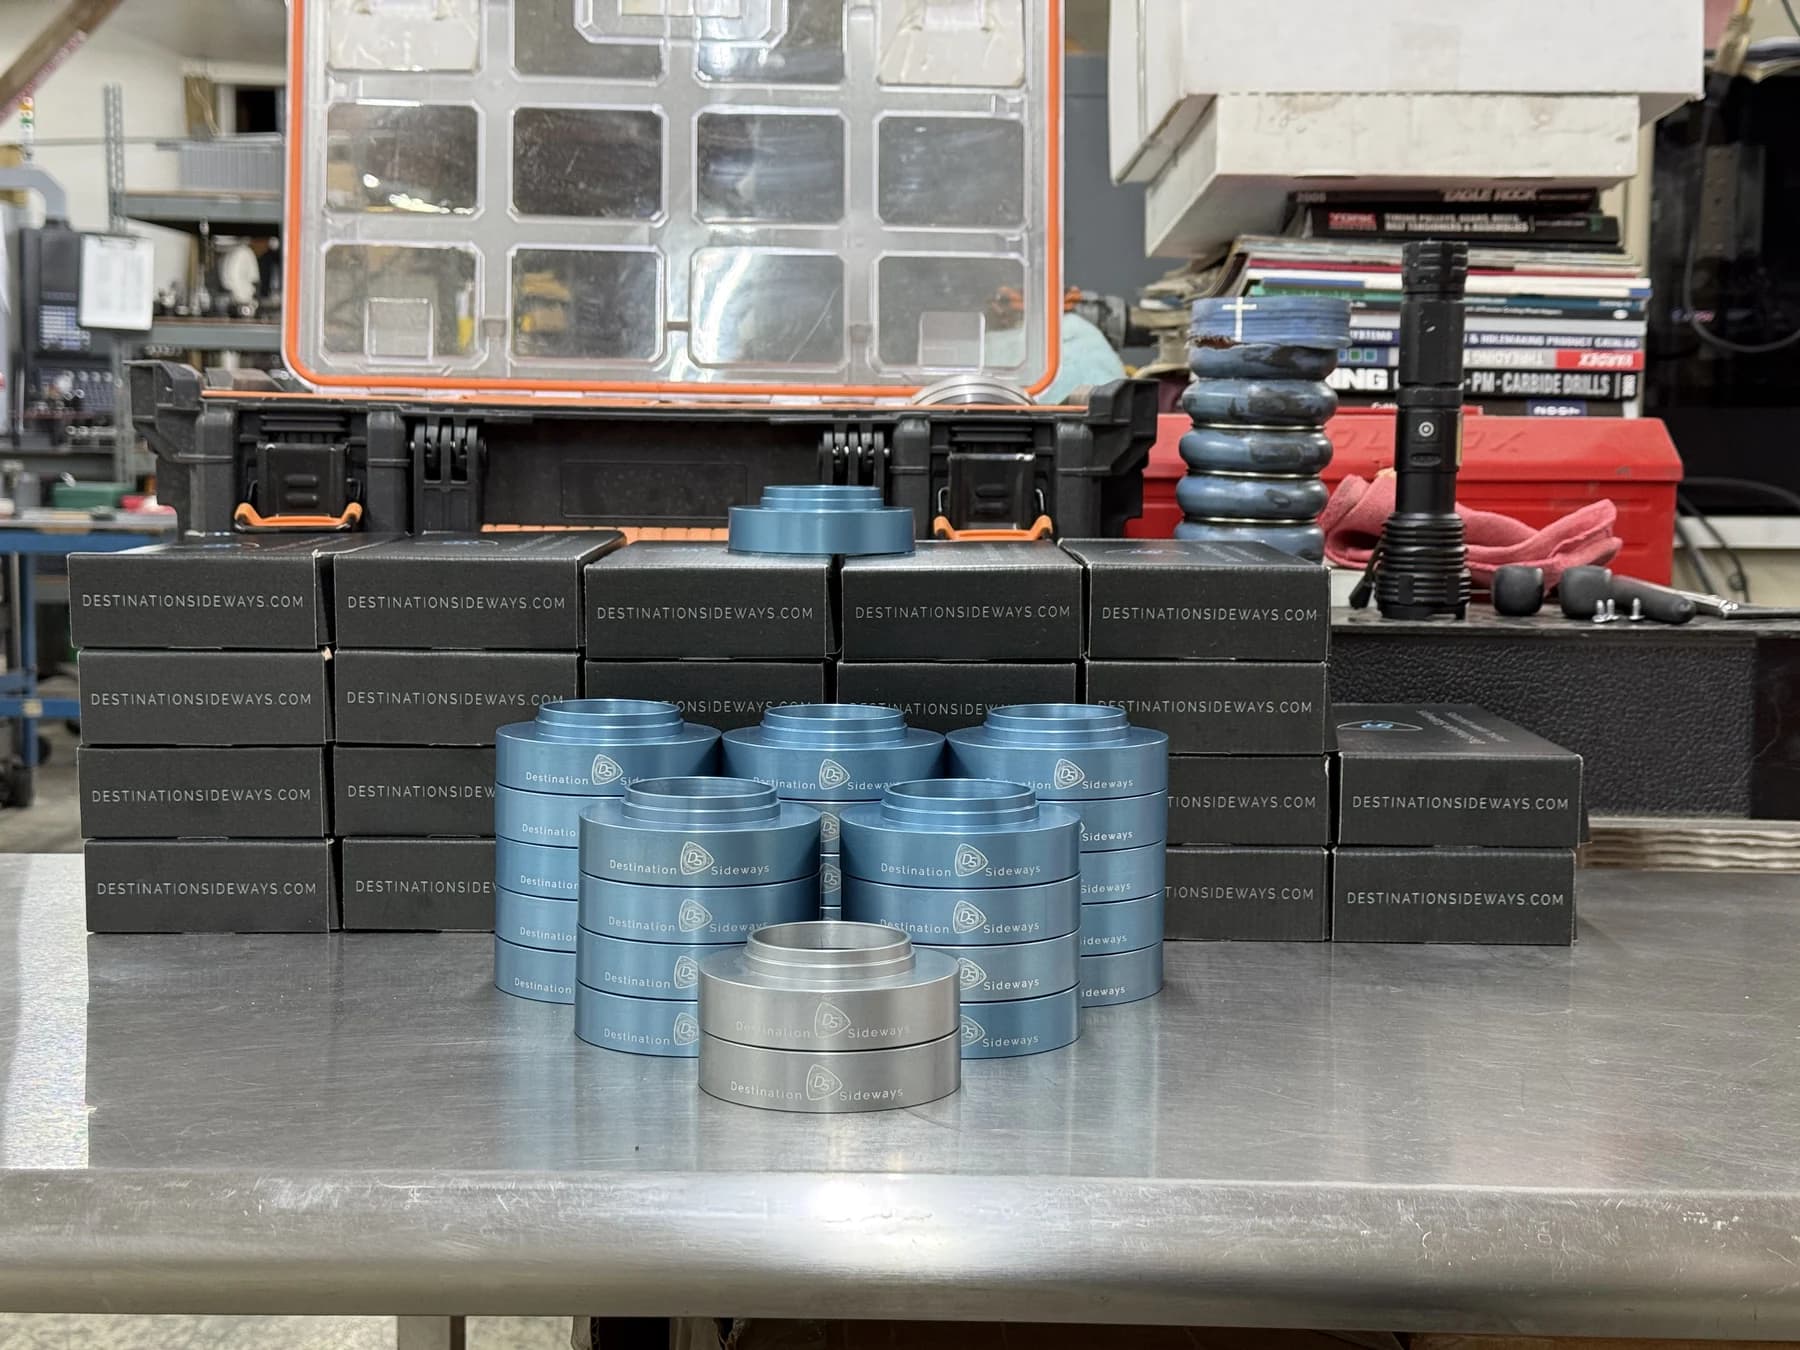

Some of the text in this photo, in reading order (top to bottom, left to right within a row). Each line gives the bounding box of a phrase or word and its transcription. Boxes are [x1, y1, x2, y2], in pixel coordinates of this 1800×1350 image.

[1562, 373, 1610, 396] DRILLS
[81, 594, 304, 608] DESTINATIONSIDEWAYS.COM
[347, 595, 566, 609] DESTINATIONSIDEWAYS.COM
[597, 606, 814, 620] DESTINATIONSIDEWAYS.COM
[855, 605, 1071, 619] DESTINATIONSIDEWAYS.COM
[1101, 606, 1318, 621] DESTINATIONSIDEWAYS.COM
[91, 692, 312, 706] DESTINATIONSIDEWAYS.COM
[525, 771, 589, 786] Destination
[1081, 779, 1134, 790] Sideways
[92, 788, 312, 803] DESTINATIONSIDEWAYS.COM
[1167, 795, 1316, 809] TIONSIDEWAYS.COM
[1352, 796, 1569, 810] DESTINATIONSIDEWAYS.COM
[521, 823, 576, 838] Destinatio
[1081, 831, 1134, 842] Sideways
[609, 859, 677, 875] Destination
[711, 865, 770, 876] Sideways
[880, 863, 952, 877] Destination
[985, 865, 1041, 877] Sideways
[97, 882, 317, 896] DESTINATIONSIDEWAYS.COM
[1080, 881, 1132, 894] Sideways
[1346, 891, 1564, 906] DESTINATIONSIDEWAYS.COM
[608, 915, 676, 932] Destination
[983, 922, 1040, 934] Sideways
[1080, 935, 1128, 946] ideways
[514, 977, 572, 995] Destination
[604, 972, 671, 989] Destination
[983, 979, 1040, 991] Sideways
[1081, 986, 1126, 998] ideways
[603, 1028, 671, 1046] Destination
[847, 1024, 910, 1039] Sideways
[982, 1036, 1039, 1048] Sideways
[730, 1081, 802, 1101] Destination
[839, 1088, 904, 1101] Sideways
